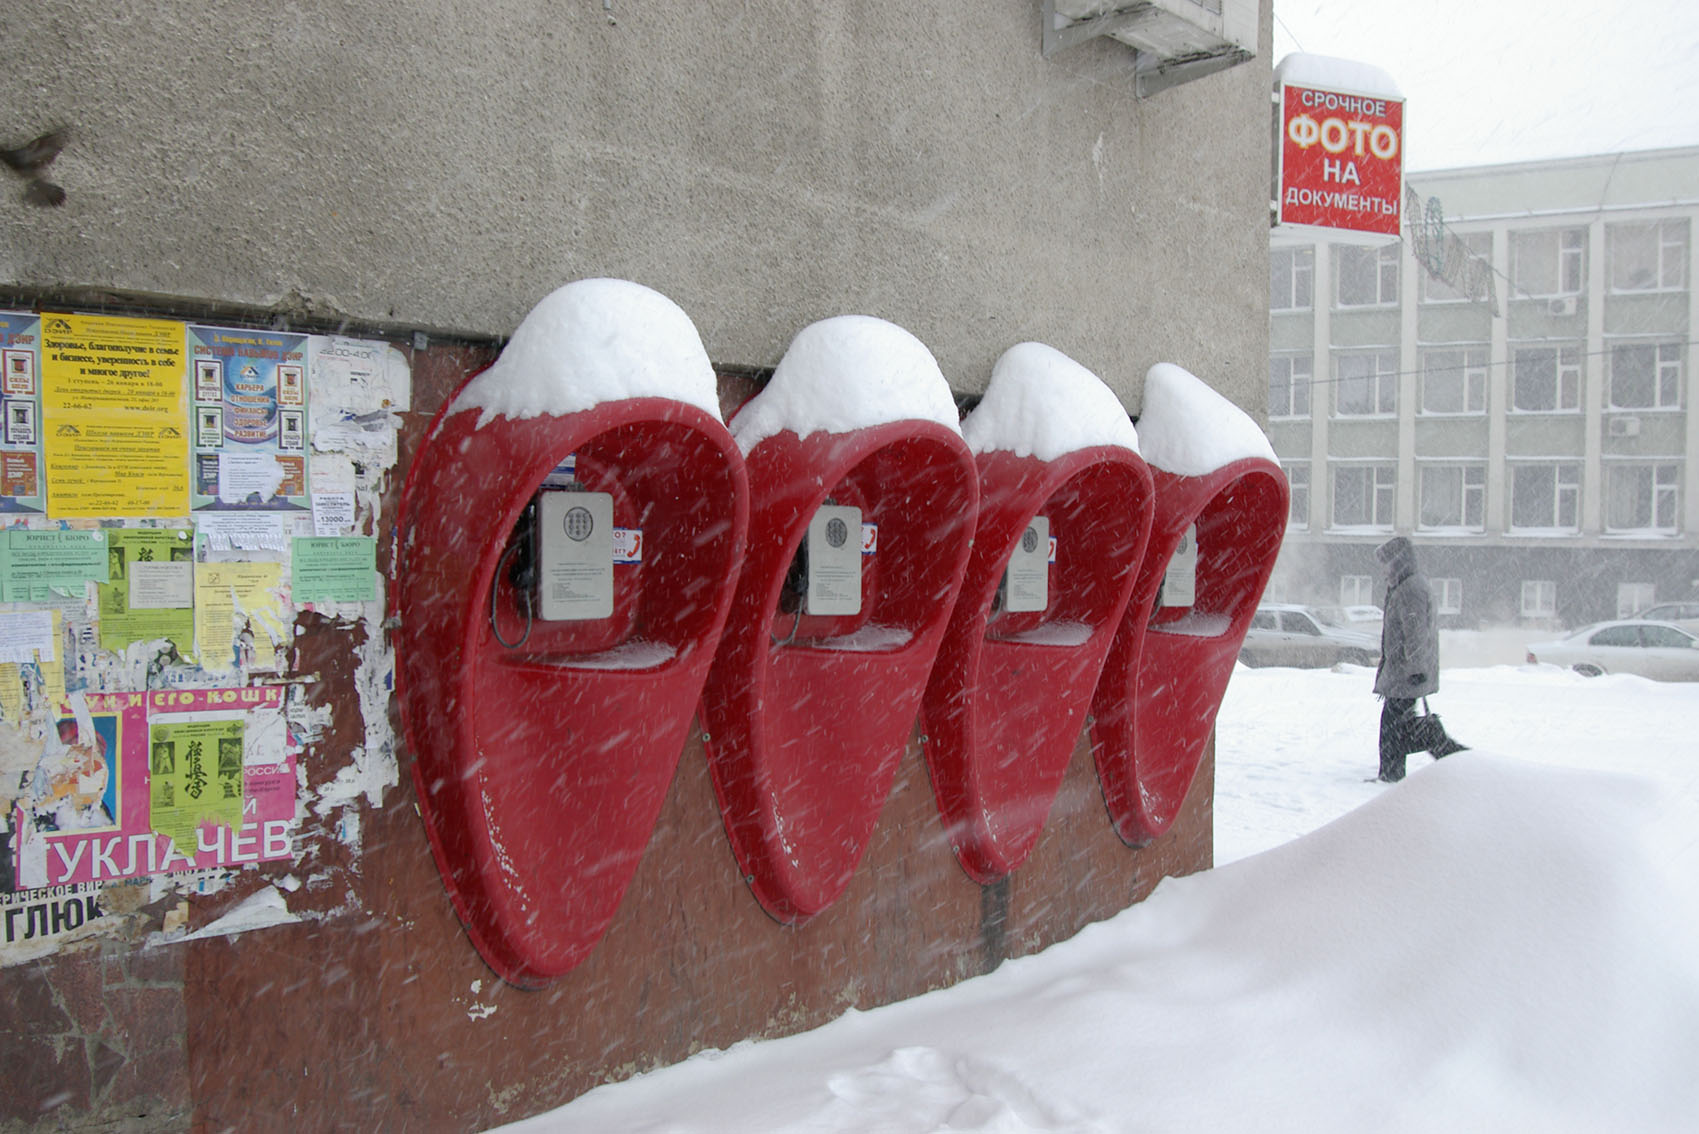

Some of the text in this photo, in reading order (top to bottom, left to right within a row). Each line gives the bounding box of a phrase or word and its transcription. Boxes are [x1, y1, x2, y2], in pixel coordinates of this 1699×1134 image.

[1301, 90, 1387, 117] СРОЧНОЕ
[1288, 113, 1399, 160] ФОТО
[1323, 158, 1360, 185] НА
[1285, 187, 1398, 215] ДОКУМЕНТЫ
[44, 339, 87, 352] Здоровье,
[88, 341, 147, 355] благополучие
[155, 347, 180, 355] семье
[59, 352, 95, 363] бизнесе,
[96, 355, 150, 366] уверенность
[158, 359, 176, 367] себе
[87, 368, 118, 376] многое
[119, 369, 150, 379] другое!
[235, 383, 265, 392] КАРЬЕРА
[154, 691, 195, 707] ЕГО
[46, 819, 293, 884] УКЛАЧЕВ
[5, 895, 104, 943] ГЛЮК
